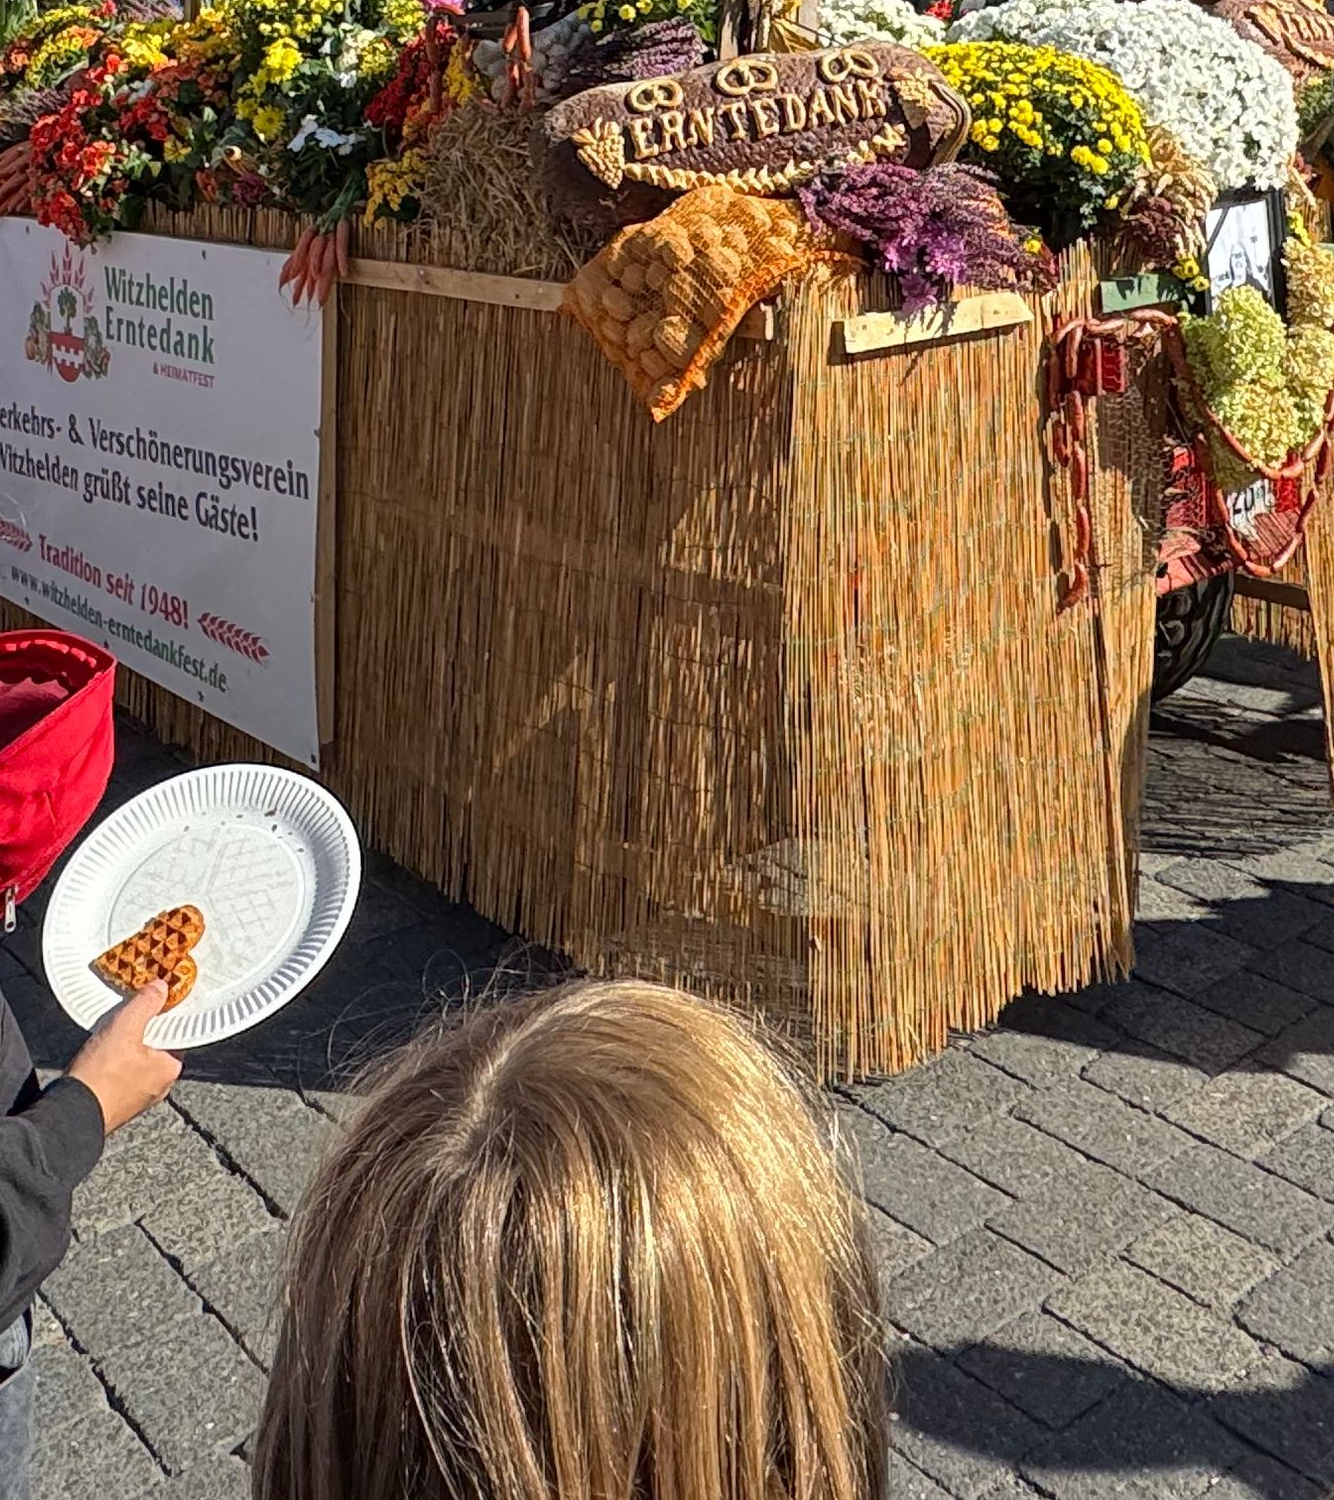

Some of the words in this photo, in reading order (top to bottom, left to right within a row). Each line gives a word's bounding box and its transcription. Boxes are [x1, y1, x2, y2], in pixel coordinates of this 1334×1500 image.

[627, 78, 888, 159] ERNTEDANK
[104, 265, 214, 320] Witzhelden
[105, 305, 215, 365] Erntedank
[160, 363, 215, 389] HEIMATFEST
[68, 412, 85, 446] &
[88, 416, 310, 500] Verschönerungsverein
[83, 468, 131, 504] grüßt
[136, 482, 189, 522] seine
[195, 491, 259, 542] Gäste!
[38, 533, 101, 589] Tradition
[106, 572, 135, 606] seit
[139, 581, 190, 630] 1948!
[10, 563, 228, 694] www.witzhelden-erntedankfest.de
